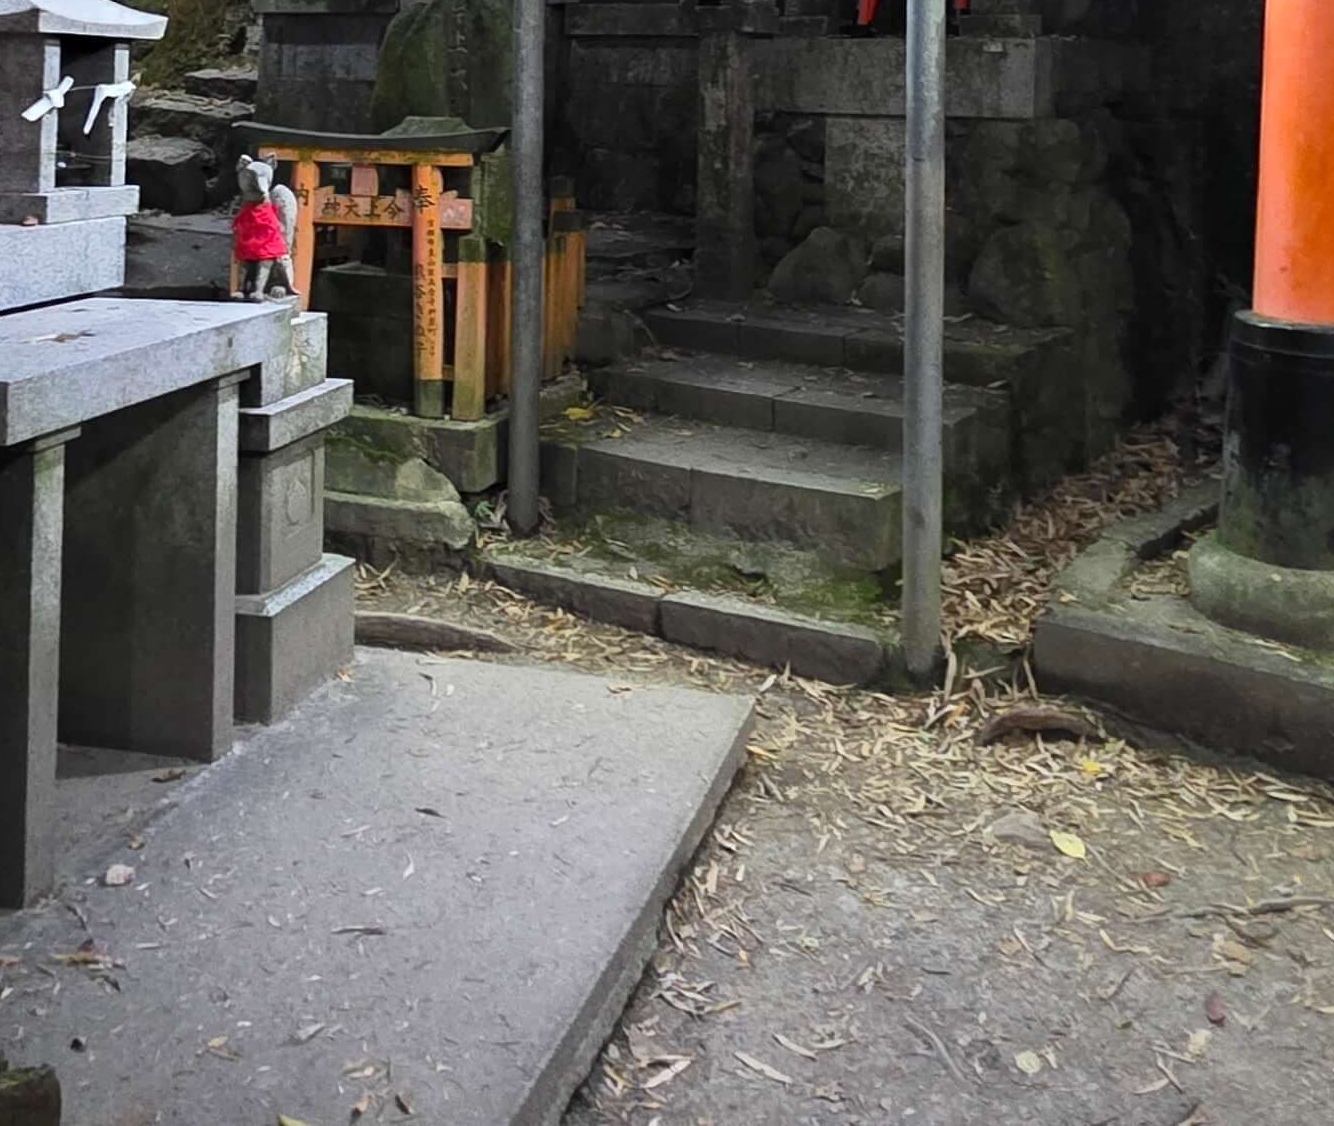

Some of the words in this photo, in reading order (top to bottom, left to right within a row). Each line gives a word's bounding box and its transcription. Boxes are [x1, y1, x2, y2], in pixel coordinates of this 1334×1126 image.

[321, 196, 404, 220] 今上大神
[412, 183, 436, 215] 奉
